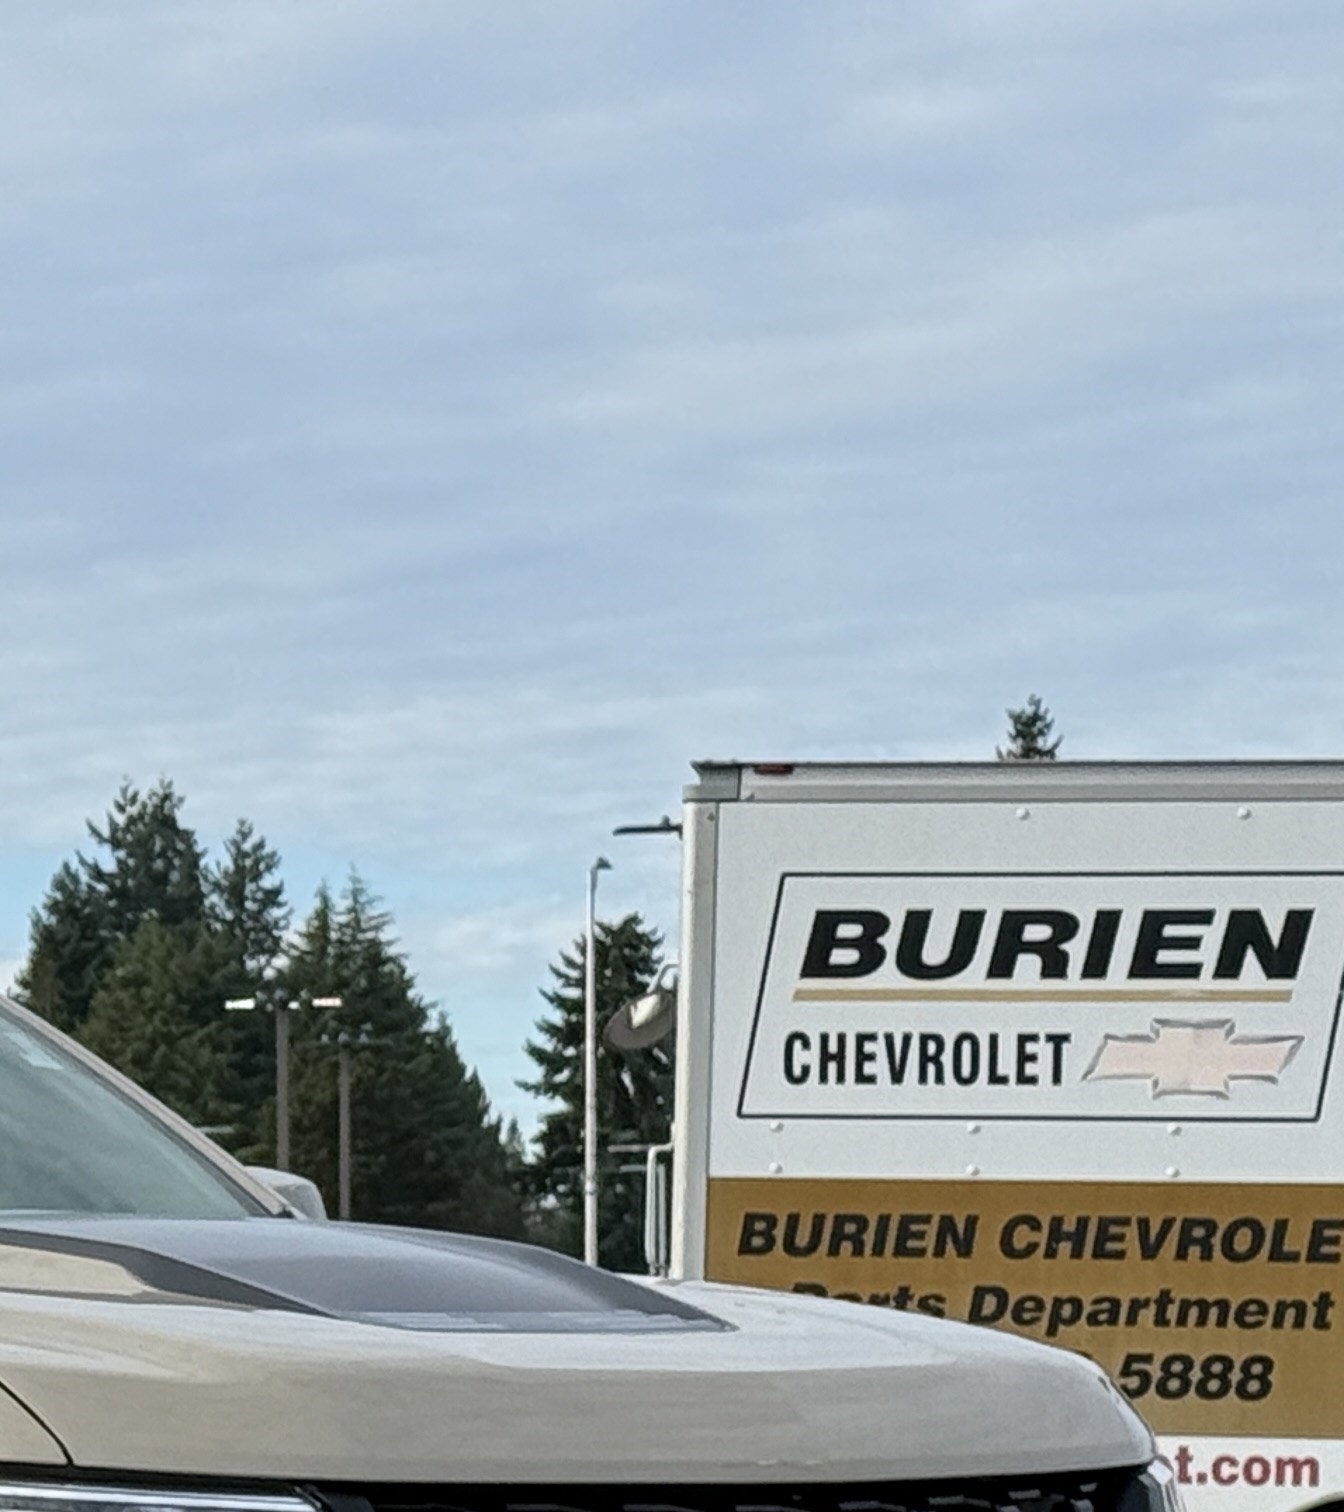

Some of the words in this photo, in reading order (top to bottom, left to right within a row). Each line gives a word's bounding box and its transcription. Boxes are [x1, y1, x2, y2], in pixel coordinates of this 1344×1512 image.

[799, 908, 1315, 980] BURIEN
[783, 1031, 1072, 1086] CHEVROLET
[738, 1211, 979, 1260] BURIEN
[968, 1284, 1333, 1337] Department
[1118, 1353, 1275, 1401] 5888
[1174, 1445, 1320, 1488] t.com
